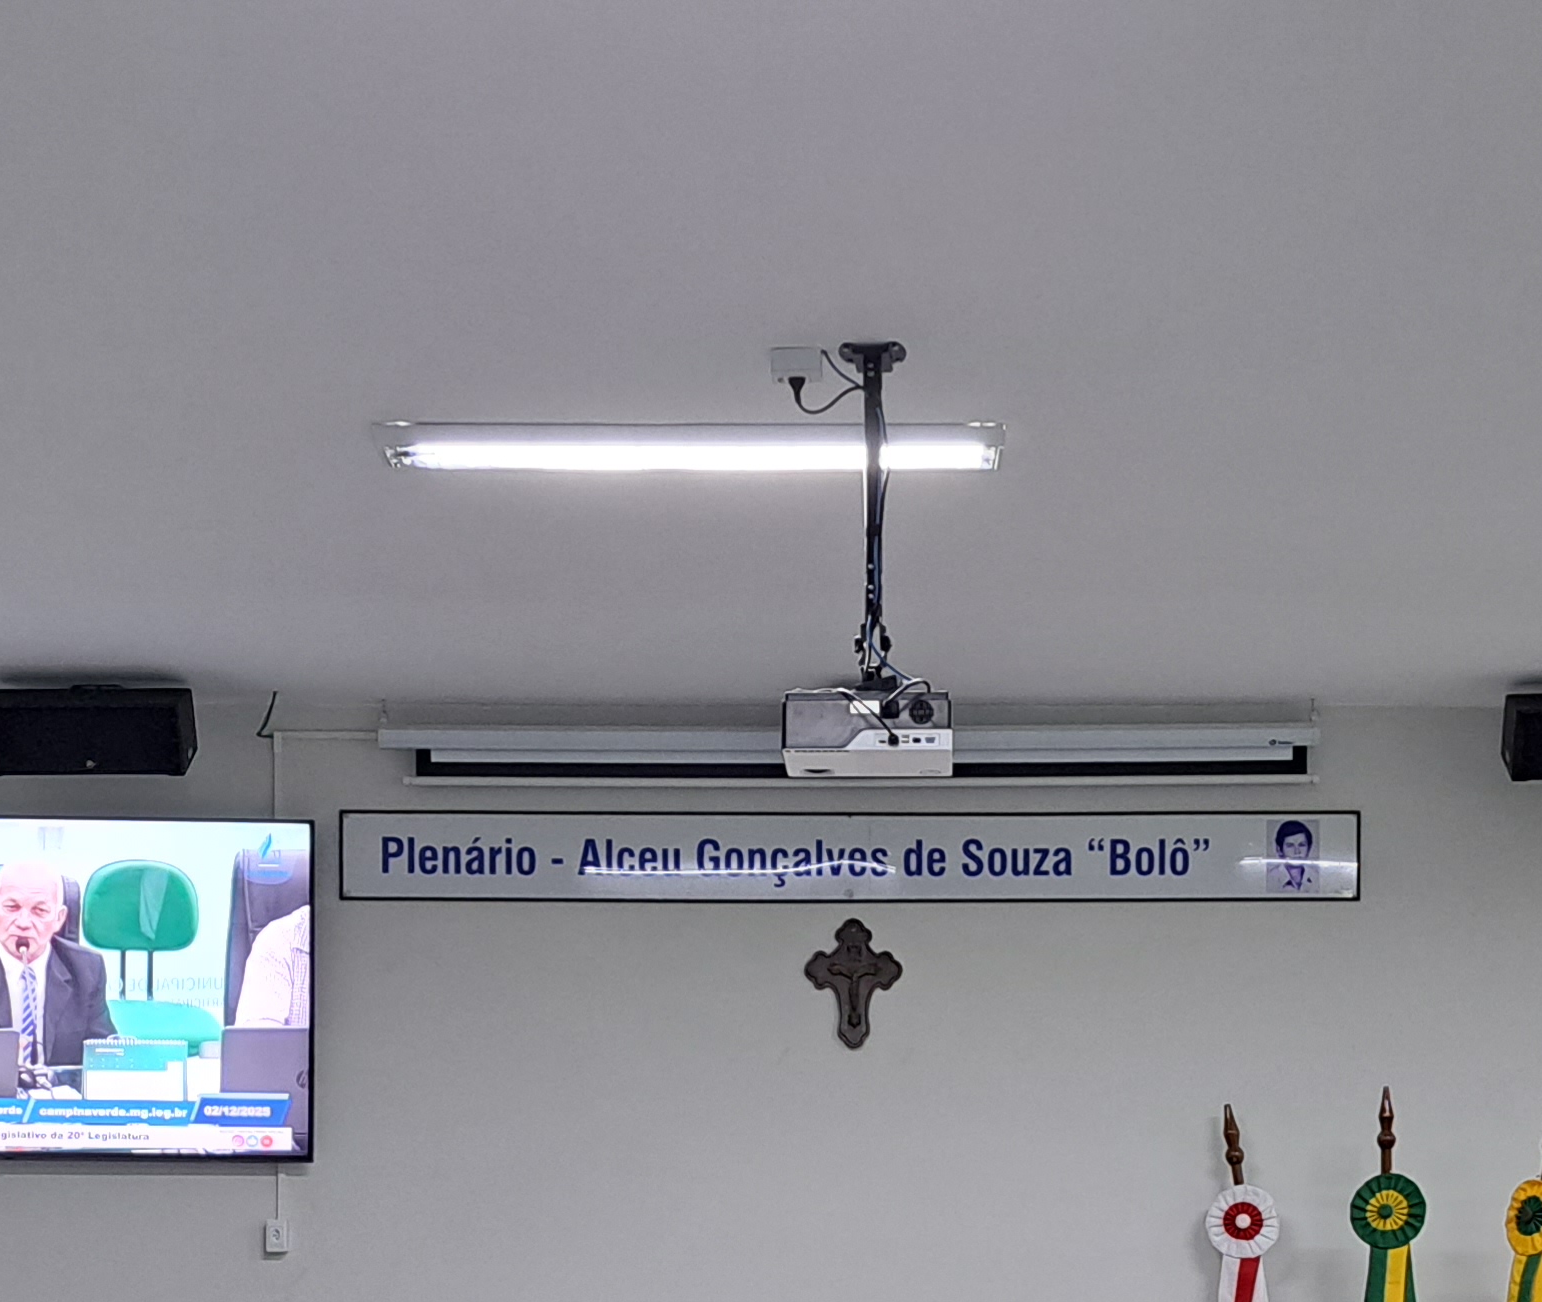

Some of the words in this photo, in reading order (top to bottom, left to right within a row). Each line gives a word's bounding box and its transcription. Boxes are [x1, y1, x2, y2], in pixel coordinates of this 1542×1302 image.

[381, 836, 537, 876] Plenário
[578, 838, 682, 876] Alceu
[695, 838, 890, 888] Gonçalves
[903, 840, 947, 877] de
[961, 838, 1073, 878] Souza
